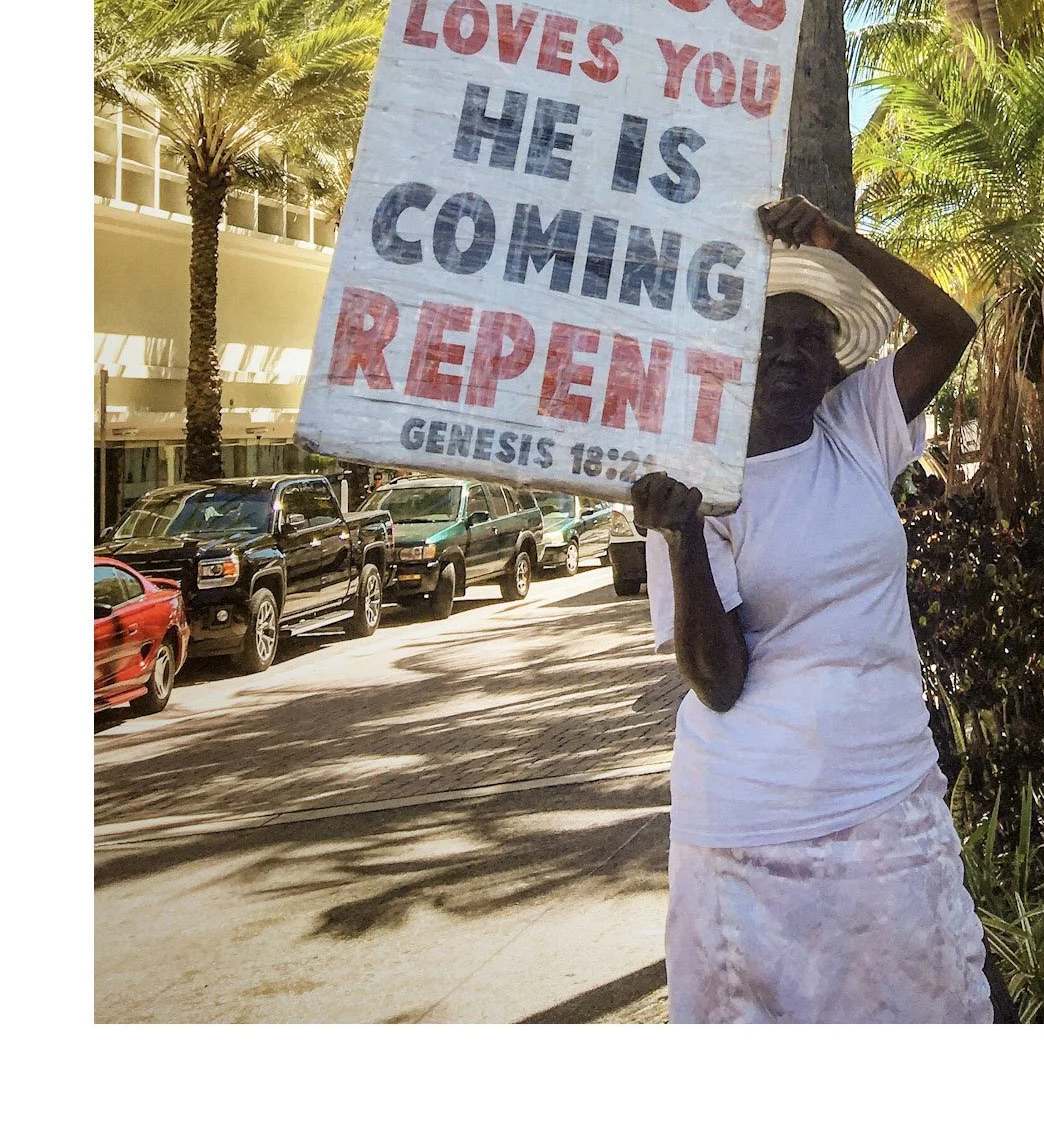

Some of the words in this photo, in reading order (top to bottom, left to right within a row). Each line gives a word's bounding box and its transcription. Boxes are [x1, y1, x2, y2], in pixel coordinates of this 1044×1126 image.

[656, 37, 782, 120] YOU
[452, 84, 580, 182] HE
[610, 113, 707, 205] IS
[370, 181, 746, 321] COMING
[327, 285, 744, 446] REPENT
[400, 417, 556, 471] GENESIS
